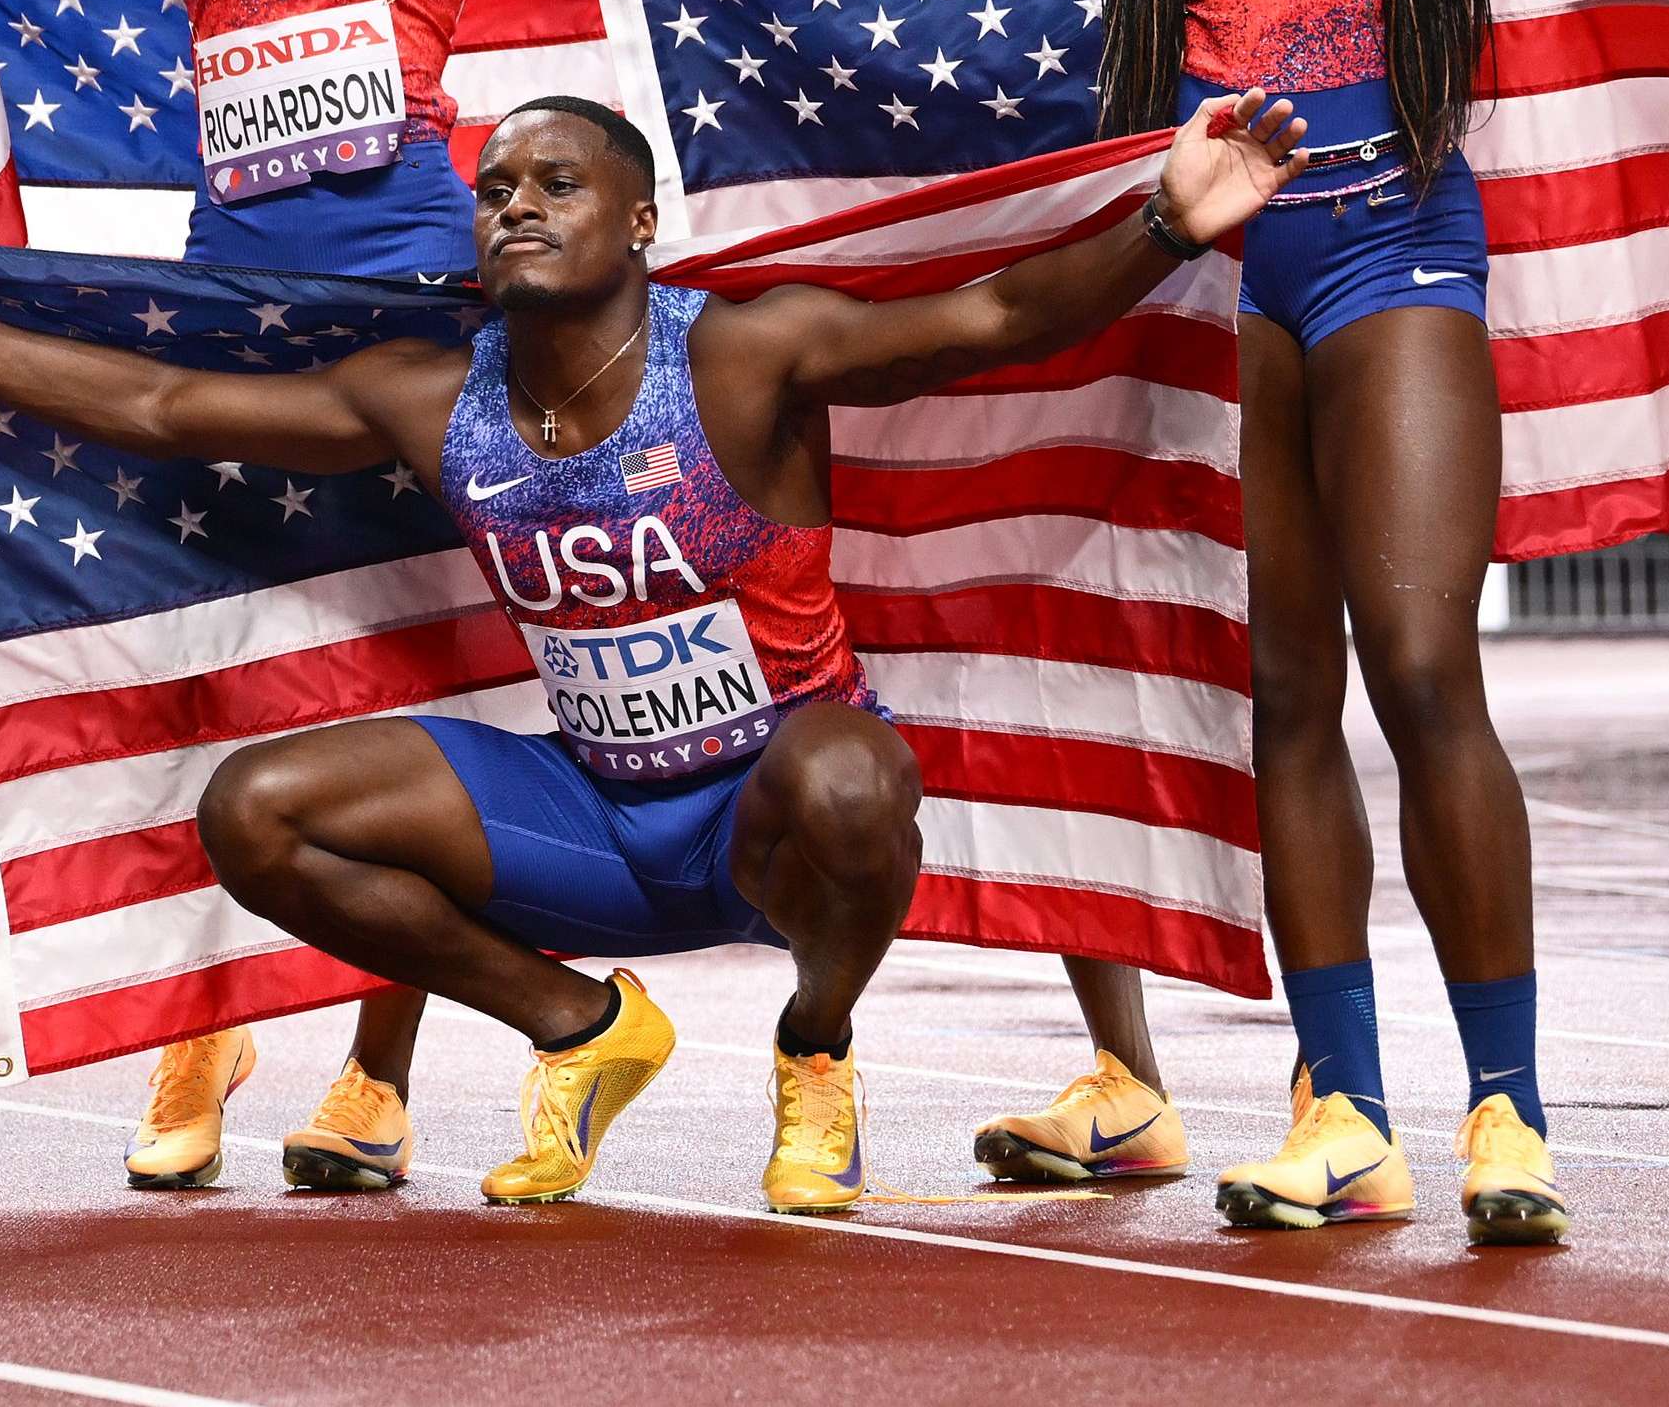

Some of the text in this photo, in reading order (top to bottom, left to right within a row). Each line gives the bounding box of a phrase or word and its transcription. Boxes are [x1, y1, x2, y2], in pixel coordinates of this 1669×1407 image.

[198, 19, 388, 86] HONDA
[204, 68, 396, 157] RICHARDSON
[486, 515, 706, 611] USA
[569, 611, 733, 680] TDK
[556, 661, 758, 738] COLEMAN
